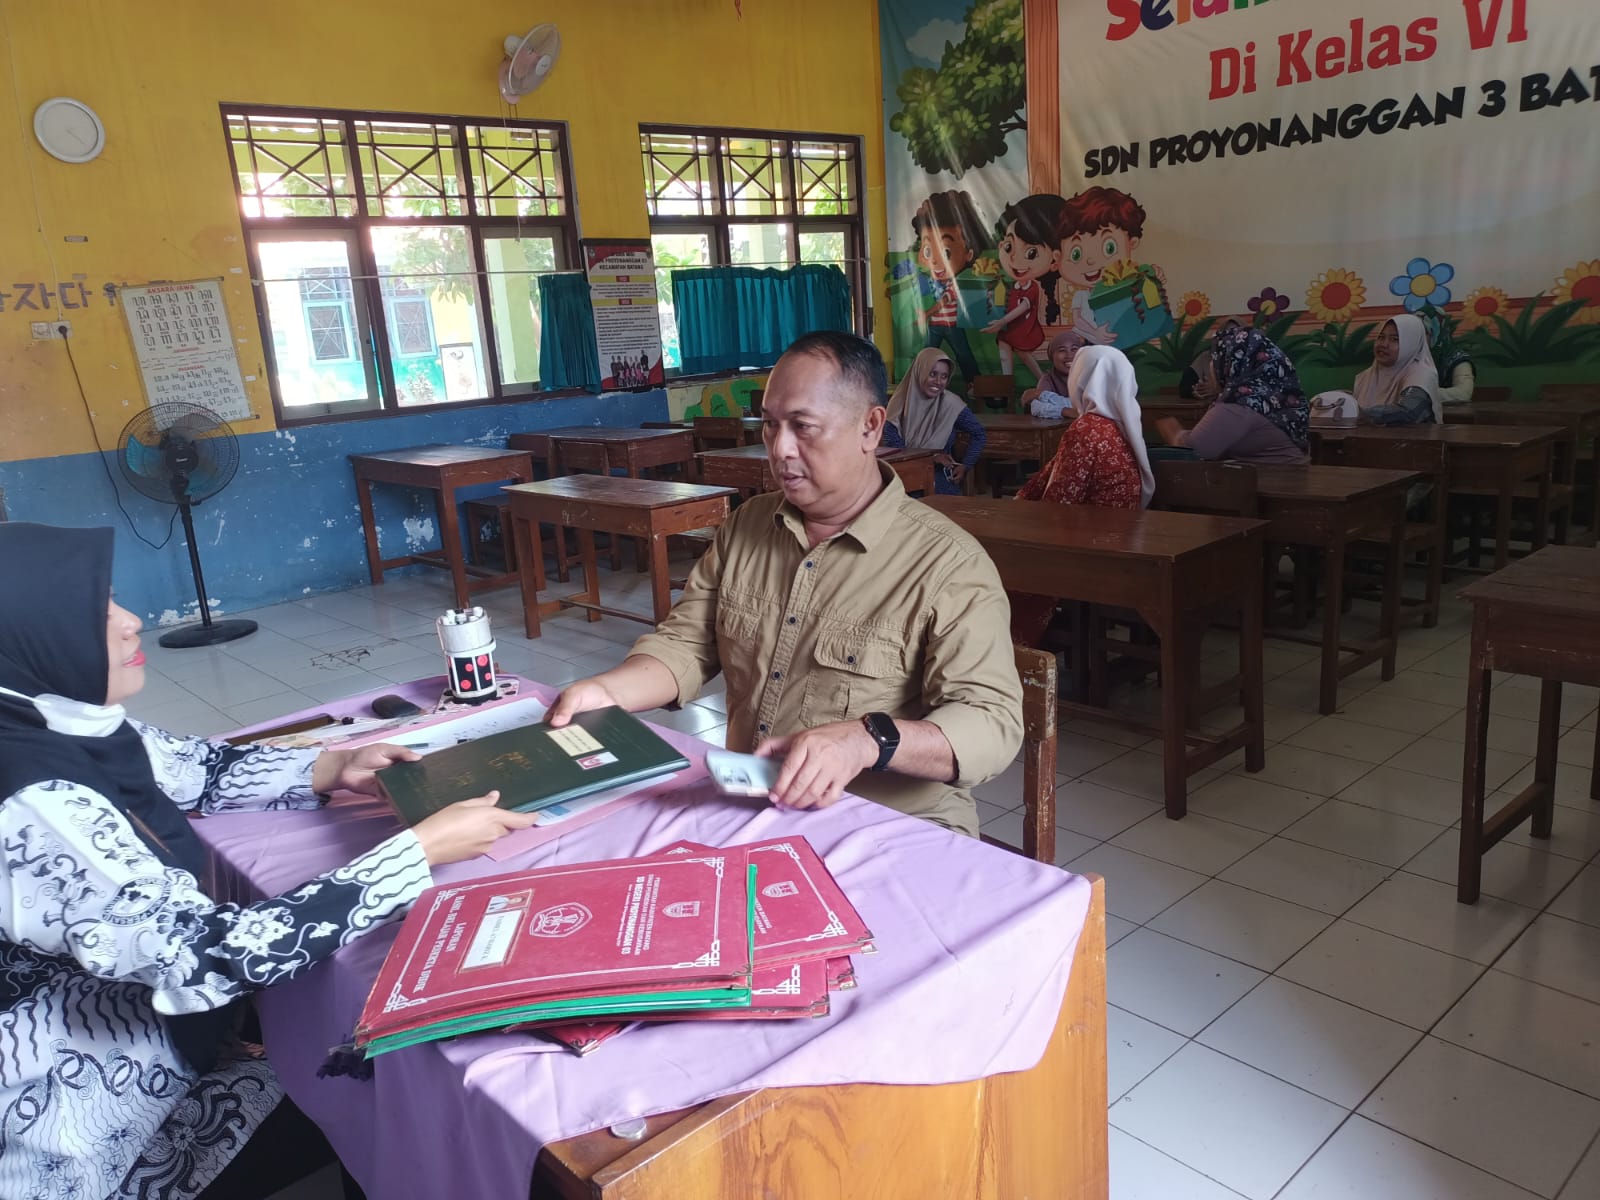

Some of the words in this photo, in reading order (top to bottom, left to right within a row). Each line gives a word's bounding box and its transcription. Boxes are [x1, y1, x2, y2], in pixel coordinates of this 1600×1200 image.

[1209, 41, 1257, 100] Di
[1276, 17, 1438, 87] Kelas
[1462, 0, 1528, 50] VI
[1084, 142, 1140, 179] SDN
[1149, 86, 1466, 169] PROYONANGGAN
[1477, 79, 1507, 118] 3
[450, 895, 466, 914] HASIL
[437, 912, 458, 941] BELAJAR
[445, 922, 467, 953] LAPORAN
[423, 939, 446, 971] PESERTA
[413, 969, 432, 994] DIDIK
